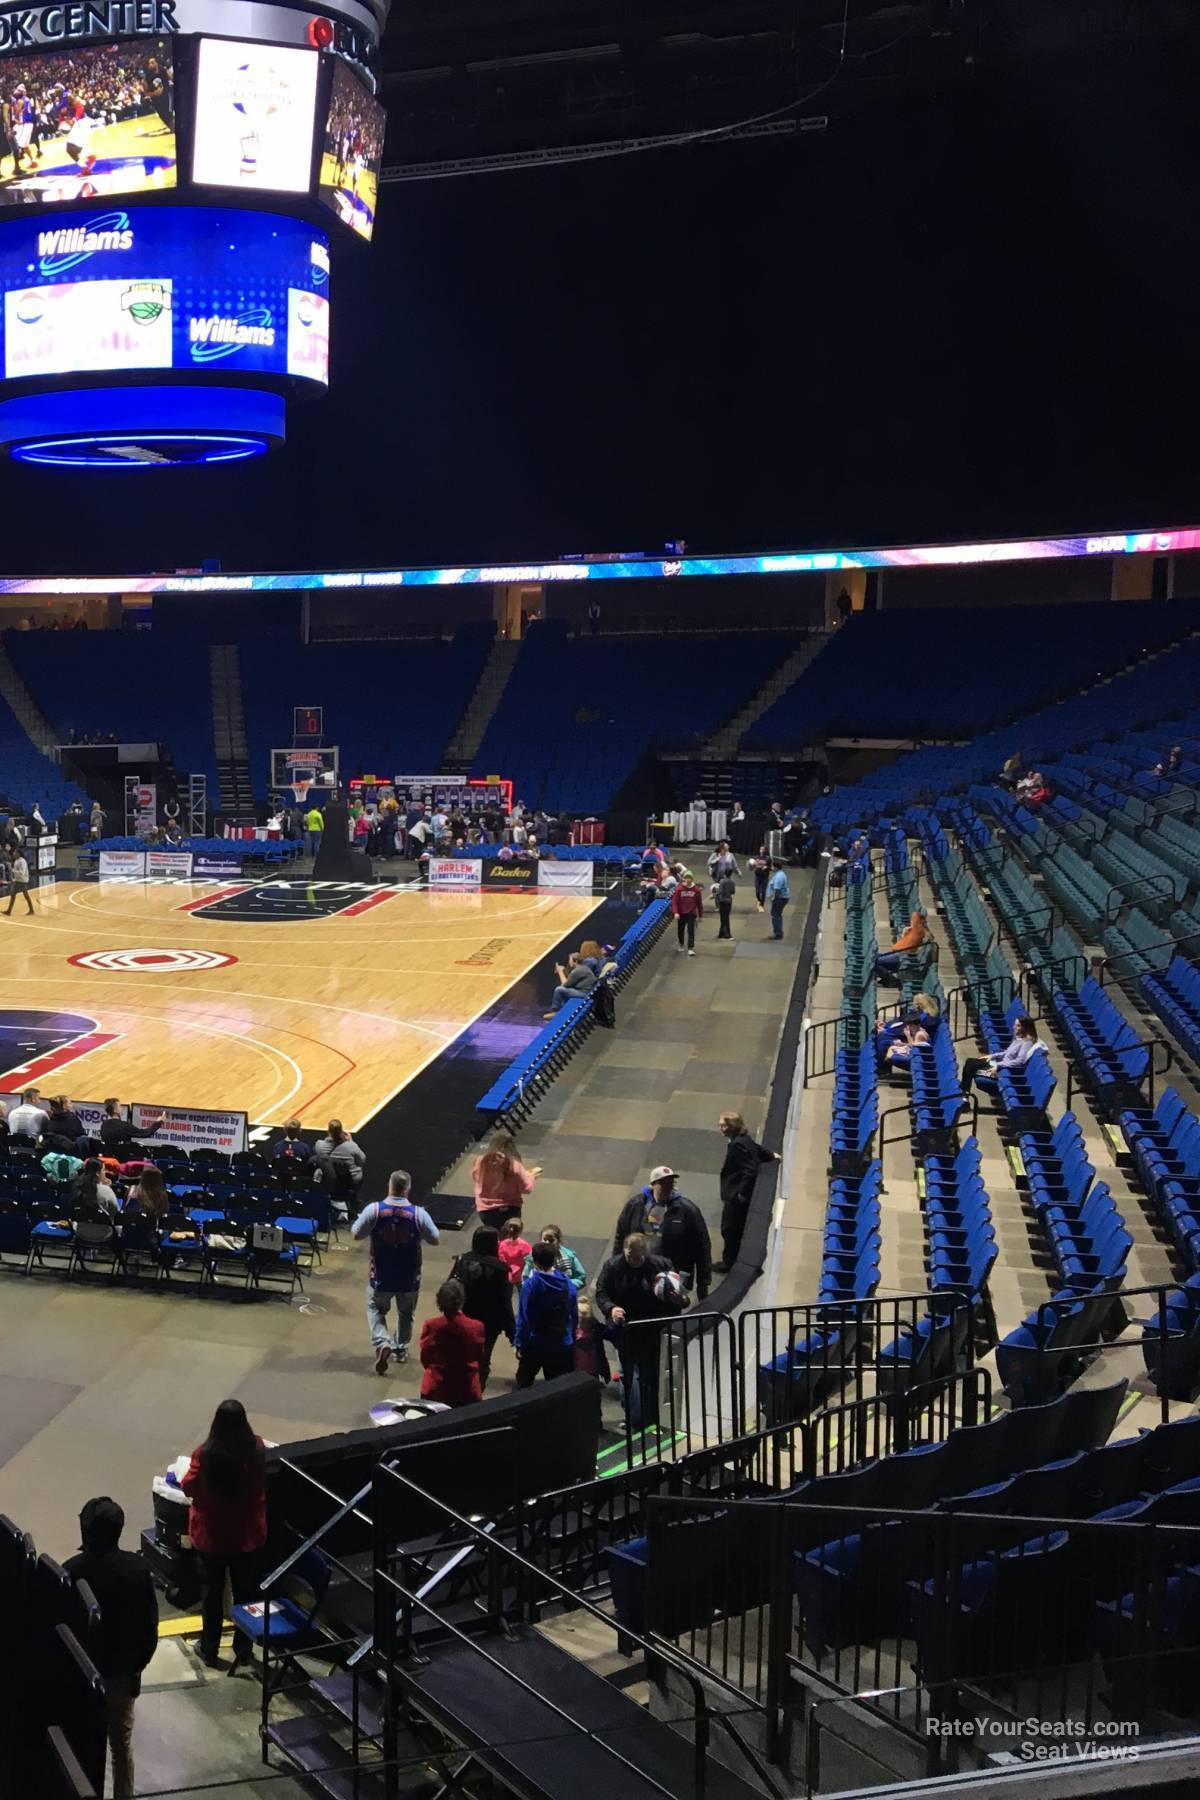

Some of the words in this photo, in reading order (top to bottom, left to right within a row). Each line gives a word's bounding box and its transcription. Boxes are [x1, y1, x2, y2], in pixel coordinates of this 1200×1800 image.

[40, 0, 181, 38] CENTER
[38, 227, 133, 256] Williams
[190, 316, 275, 346] Williams
[437, 863, 473, 873] HARLEM
[489, 865, 532, 878] Baden
[193, 1125, 206, 1133] The
[207, 1126, 236, 1136] Original
[170, 1133, 217, 1145] Globetrotters
[261, 1231, 275, 1242] F1
